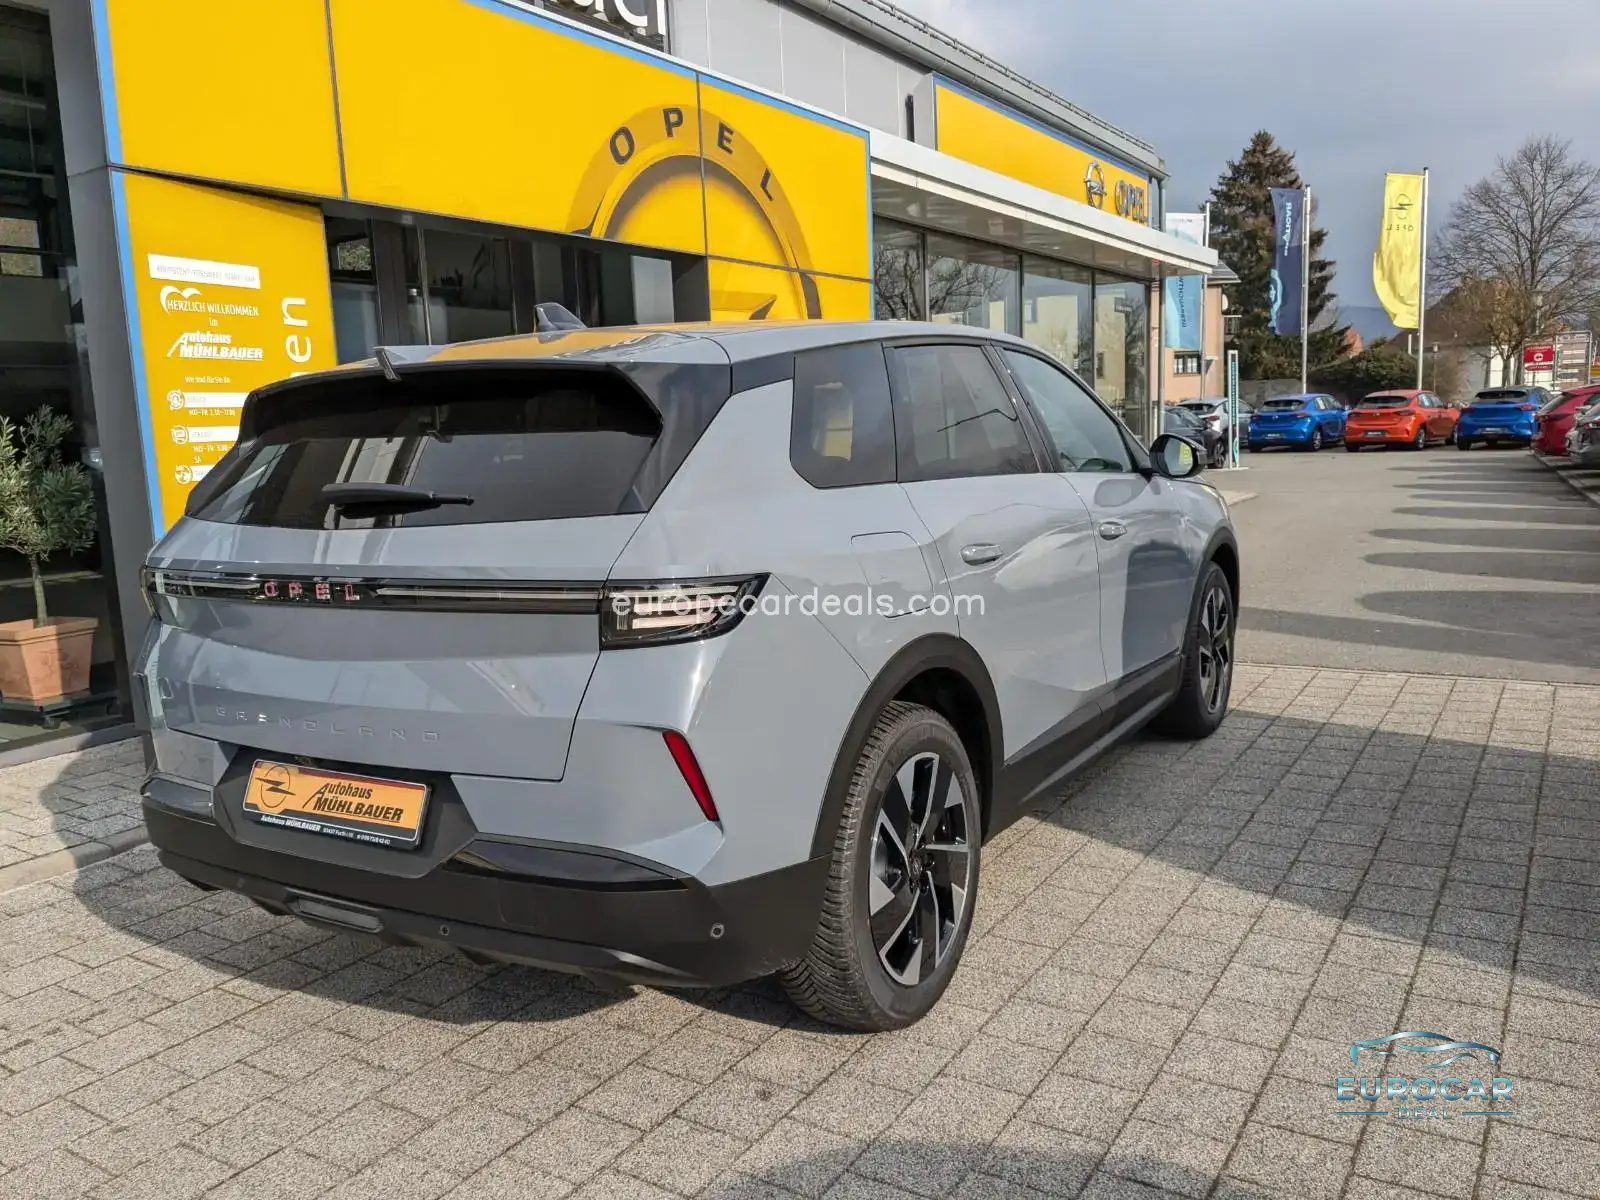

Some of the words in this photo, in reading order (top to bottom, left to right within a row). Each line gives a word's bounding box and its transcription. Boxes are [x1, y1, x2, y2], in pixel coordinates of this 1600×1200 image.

[609, 106, 774, 202] OPEL
[167, 300, 206, 312] HERZLICH
[207, 303, 260, 316] WILLKOMMEN
[166, 331, 232, 358] Autohaus
[180, 344, 263, 360] MÜHLBAUER
[263, 579, 361, 601] OPEL
[216, 704, 440, 743] GRANDLAND
[303, 783, 373, 808] Autohaus
[314, 796, 404, 822] MÜHLBAUER
[260, 815, 286, 826] Autohaus
[285, 818, 321, 831] MÜHLBAUER
